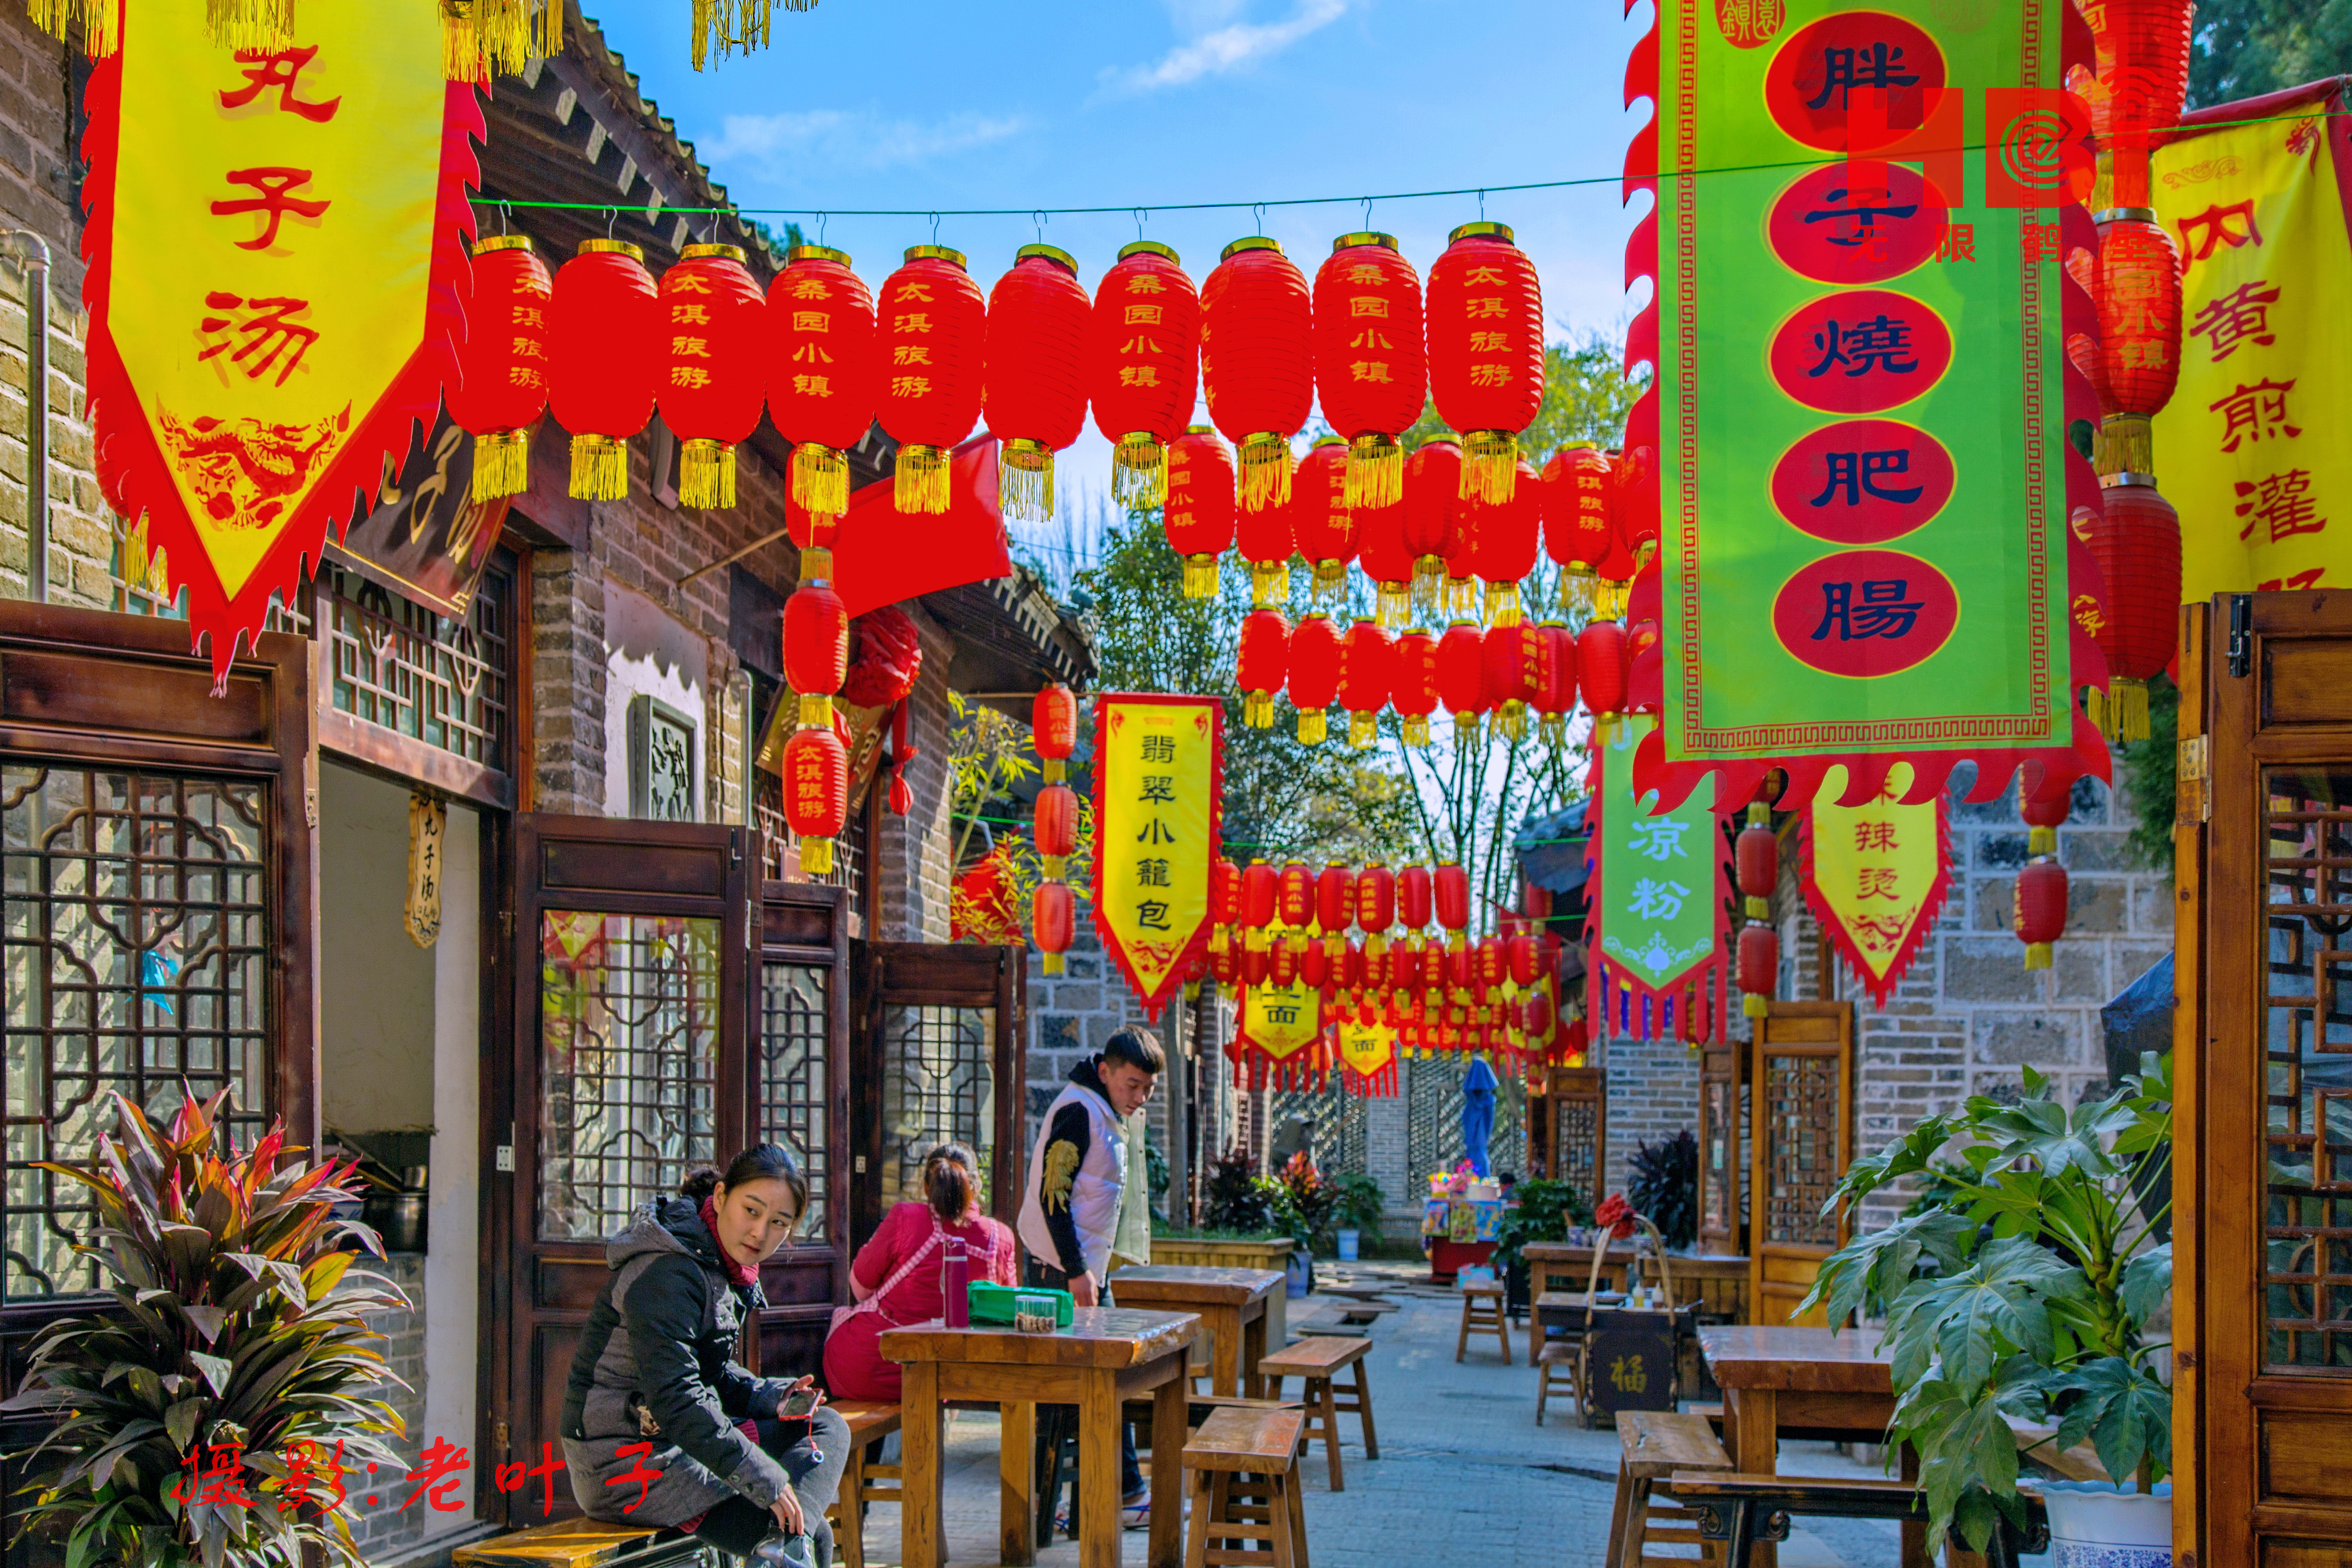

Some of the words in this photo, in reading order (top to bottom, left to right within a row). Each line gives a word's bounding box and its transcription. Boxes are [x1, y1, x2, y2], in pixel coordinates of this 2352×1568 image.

[198, 44, 342, 388] 丸子汤
[510, 277, 550, 390] 太淇旅游
[671, 274, 713, 389] 太淇旅游
[792, 279, 834, 398] 桑园小镇
[892, 282, 935, 398] 太淇旅游
[1119, 274, 1167, 388] 桑园小镇
[1347, 265, 1394, 384] 桑园小镇
[1463, 265, 1514, 388] 太淇旅游
[1805, 42, 1926, 641] 胖子燒肥腸
[2109, 247, 2169, 370] 园小镇
[2178, 199, 2342, 590] 内黄煎灌
[796, 746, 827, 818] 太淇旅游
[1136, 735, 1176, 931] 翡翠小籠包
[1628, 788, 1691, 920] 凉粉
[1610, 1354, 1647, 1394] 福
